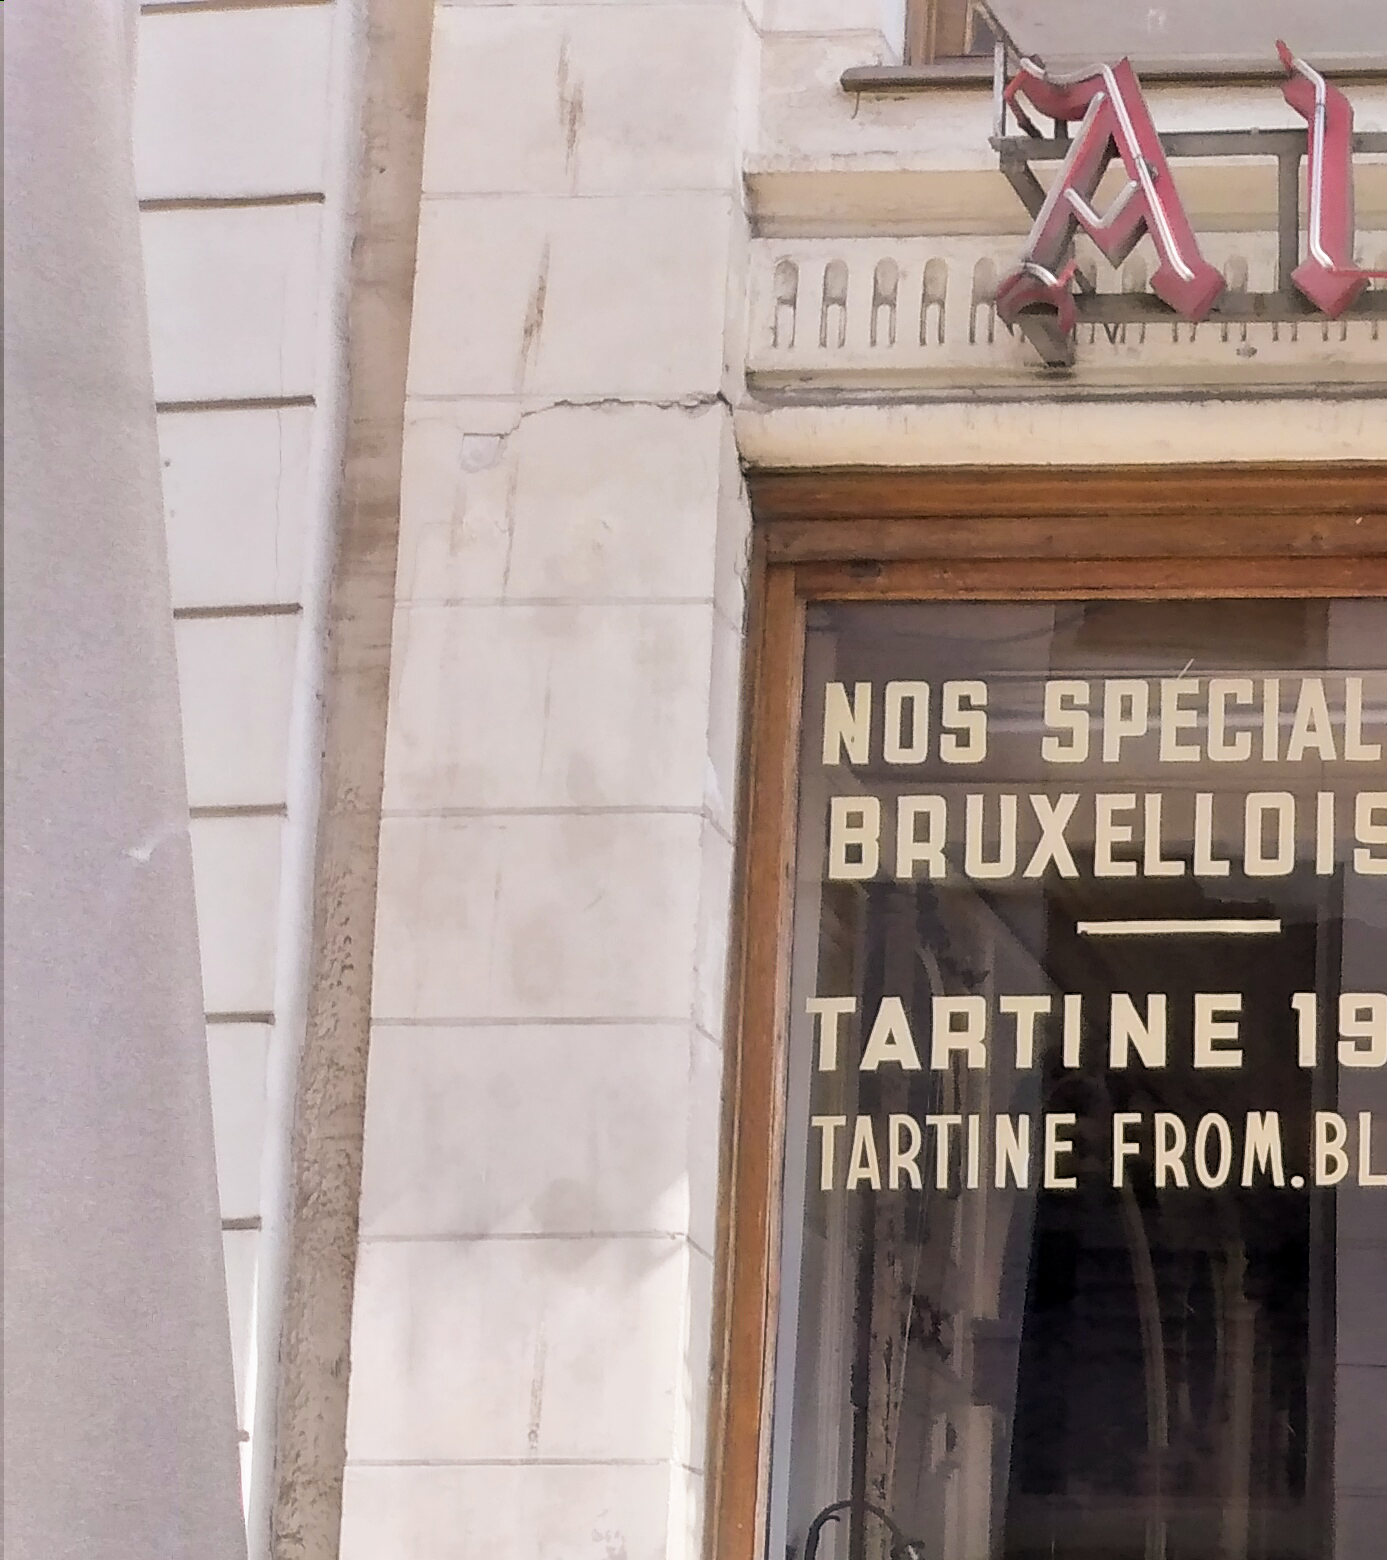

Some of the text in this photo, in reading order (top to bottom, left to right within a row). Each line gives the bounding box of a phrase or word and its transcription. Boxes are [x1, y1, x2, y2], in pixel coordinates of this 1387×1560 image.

[1000, 55, 1227, 333] A
[822, 680, 989, 765] NOS
[804, 992, 1244, 1071] TARTINE
[811, 1112, 1078, 1192] TARTINE
